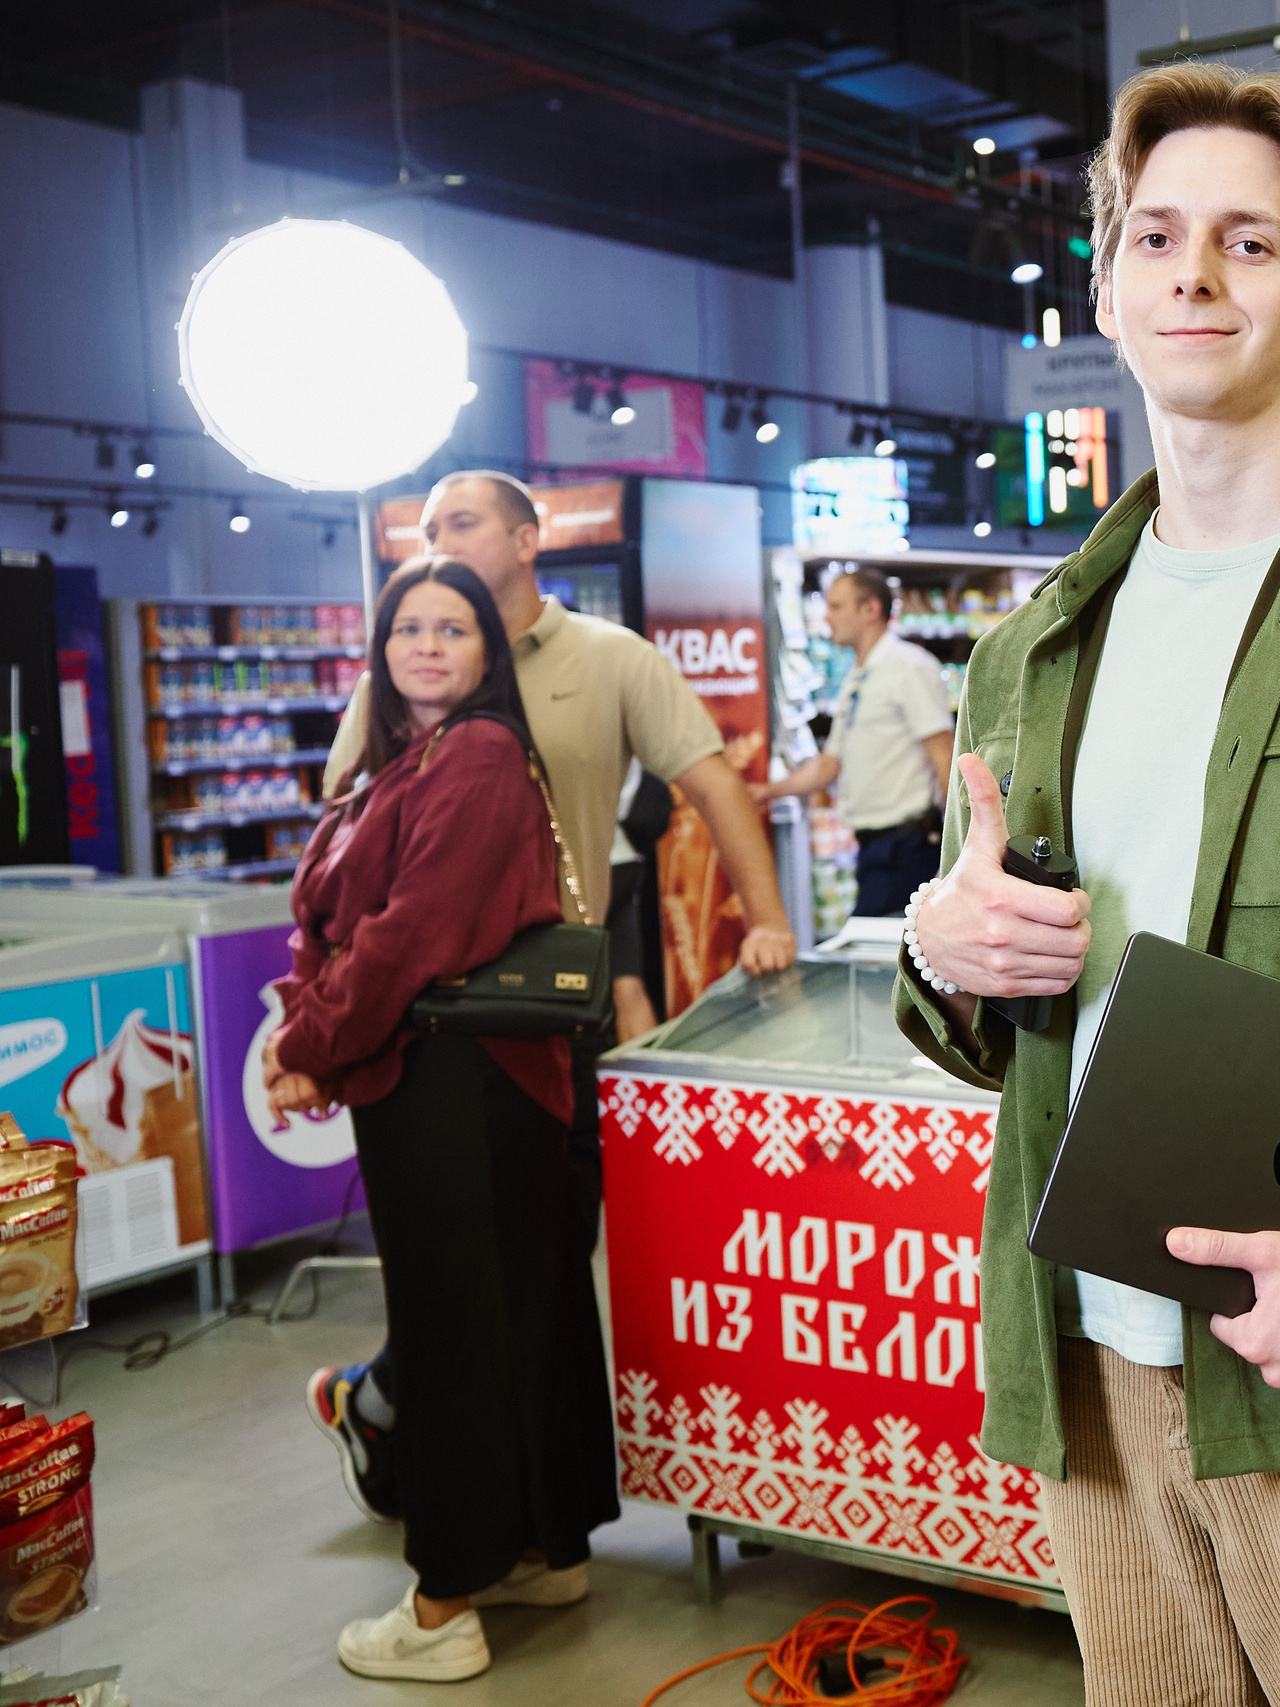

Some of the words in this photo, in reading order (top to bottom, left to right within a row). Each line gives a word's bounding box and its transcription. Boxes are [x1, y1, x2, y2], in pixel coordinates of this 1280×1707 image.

[654, 627, 758, 675] КВАС
[0, 1029, 58, 1061] ИМОС
[723, 1208, 981, 1308] МОРОЖ
[671, 1277, 752, 1352] ИЗ
[17, 1463, 81, 1504] STRONG
